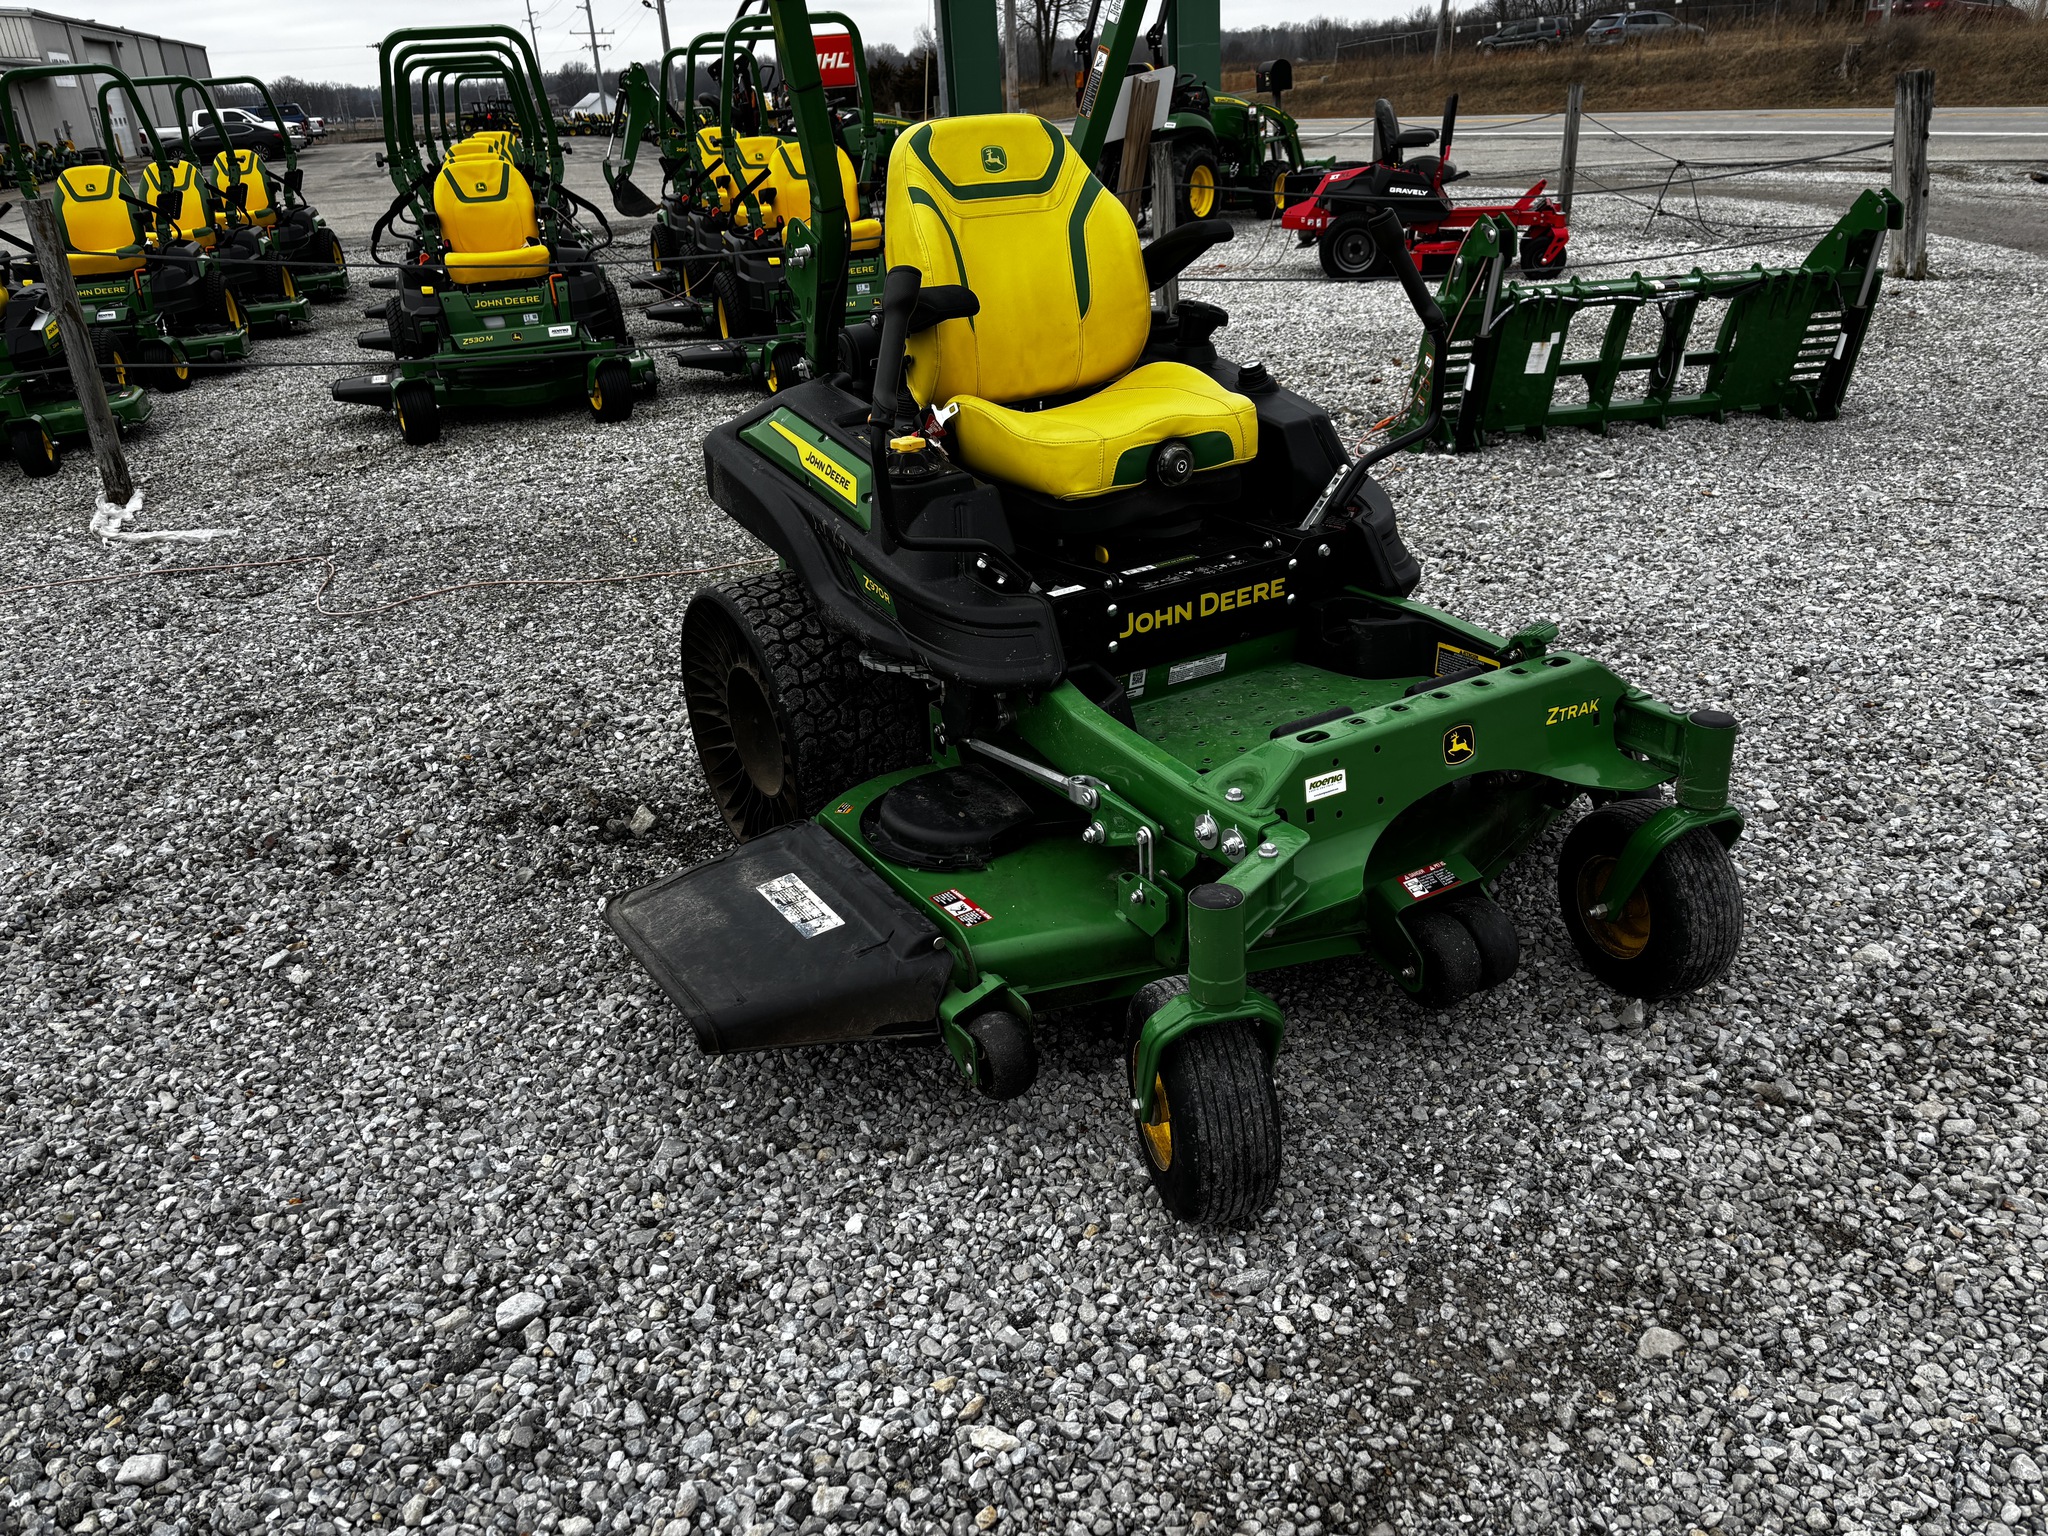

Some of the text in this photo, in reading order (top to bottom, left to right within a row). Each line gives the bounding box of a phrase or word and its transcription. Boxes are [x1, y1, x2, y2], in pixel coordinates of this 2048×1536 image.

[816, 52, 850, 69] IHL
[1389, 187, 1428, 196] GRAVELY
[849, 265, 874, 275] EERE
[94, 287, 126, 295] DEERE
[475, 296, 540, 309] JOHN DEERE
[806, 451, 850, 490] JOHN DEERE
[863, 574, 890, 604] Z970R
[1119, 577, 1286, 638] JOHN DEERE
[1546, 697, 1600, 725] ZTRAK
